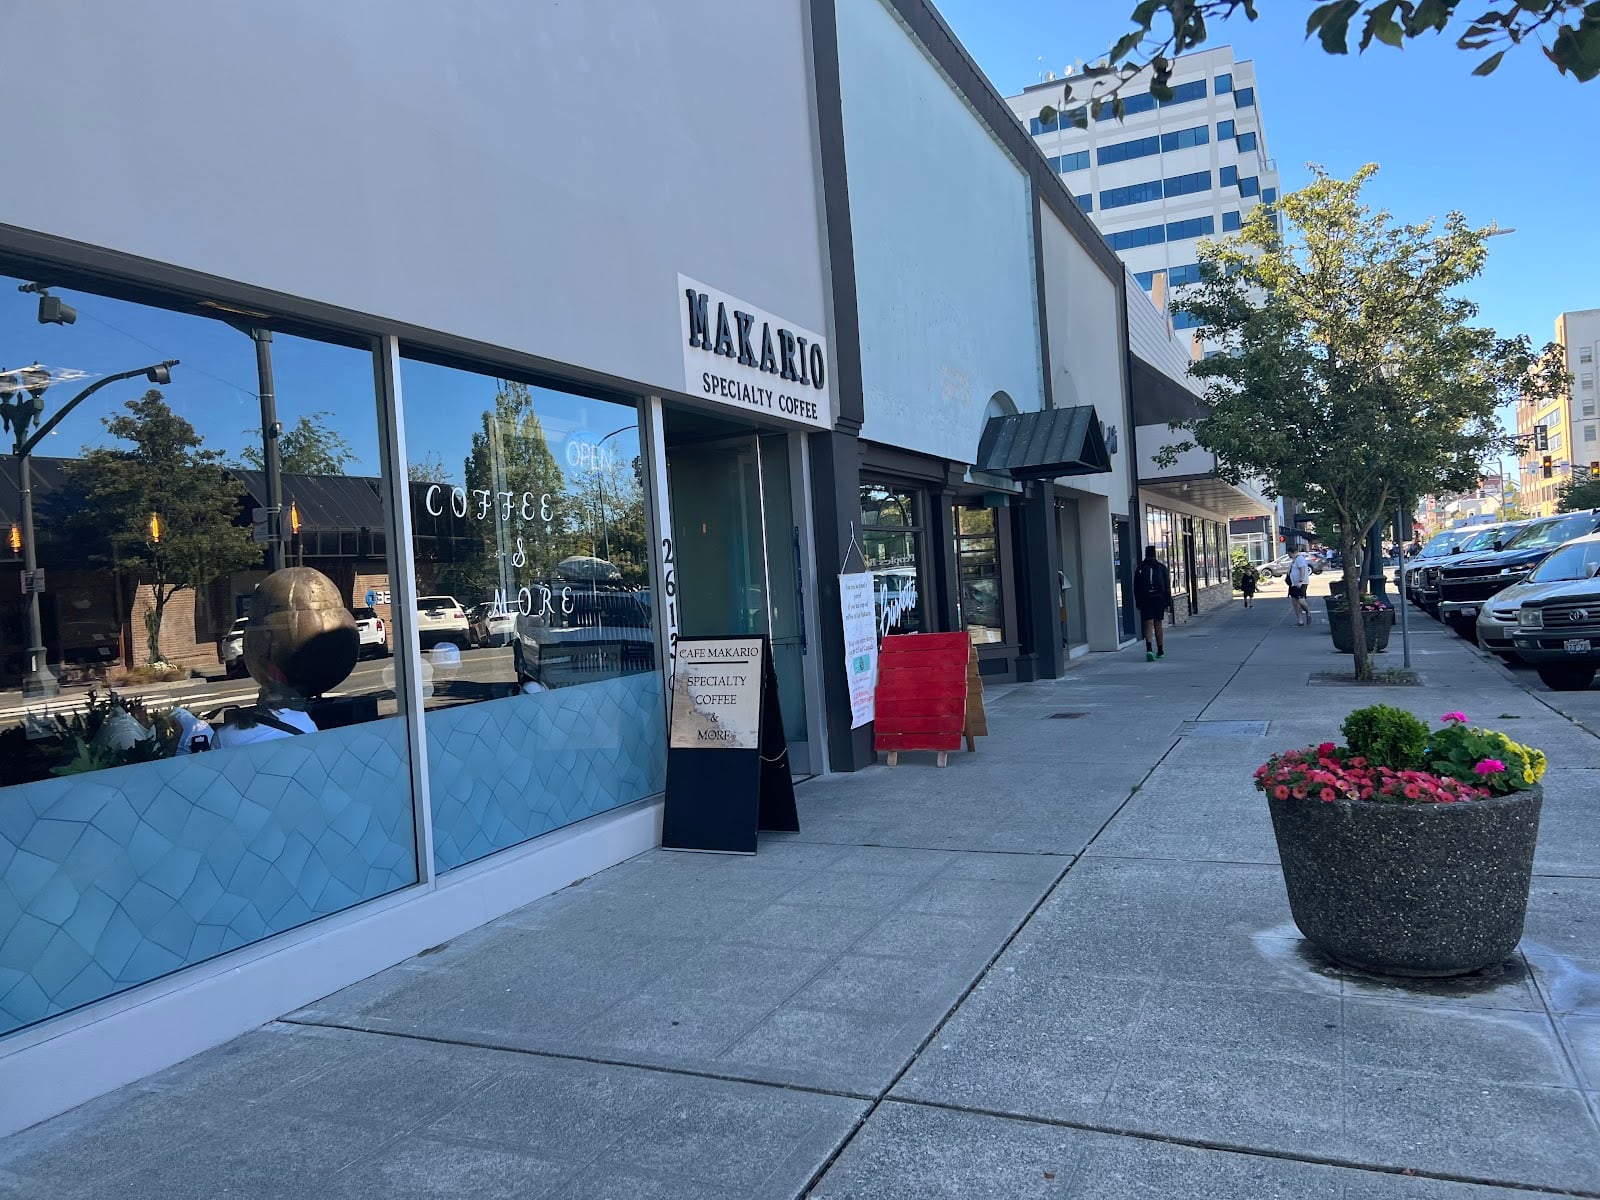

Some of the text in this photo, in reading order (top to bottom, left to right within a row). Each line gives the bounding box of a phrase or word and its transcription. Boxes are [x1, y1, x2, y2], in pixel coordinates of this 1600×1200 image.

[685, 288, 825, 390] MAKARIO
[702, 372, 818, 420] SPECIALTY COFFEE
[565, 440, 612, 473] OPEN
[425, 484, 553, 522] COFFEE
[487, 586, 575, 618] MORE
[679, 647, 759, 659] CAFE MAKARIO
[687, 676, 747, 687] SPECIALTY
[695, 694, 737, 705] COFFEE
[710, 713, 719, 722] &
[697, 729, 731, 740] MORE
